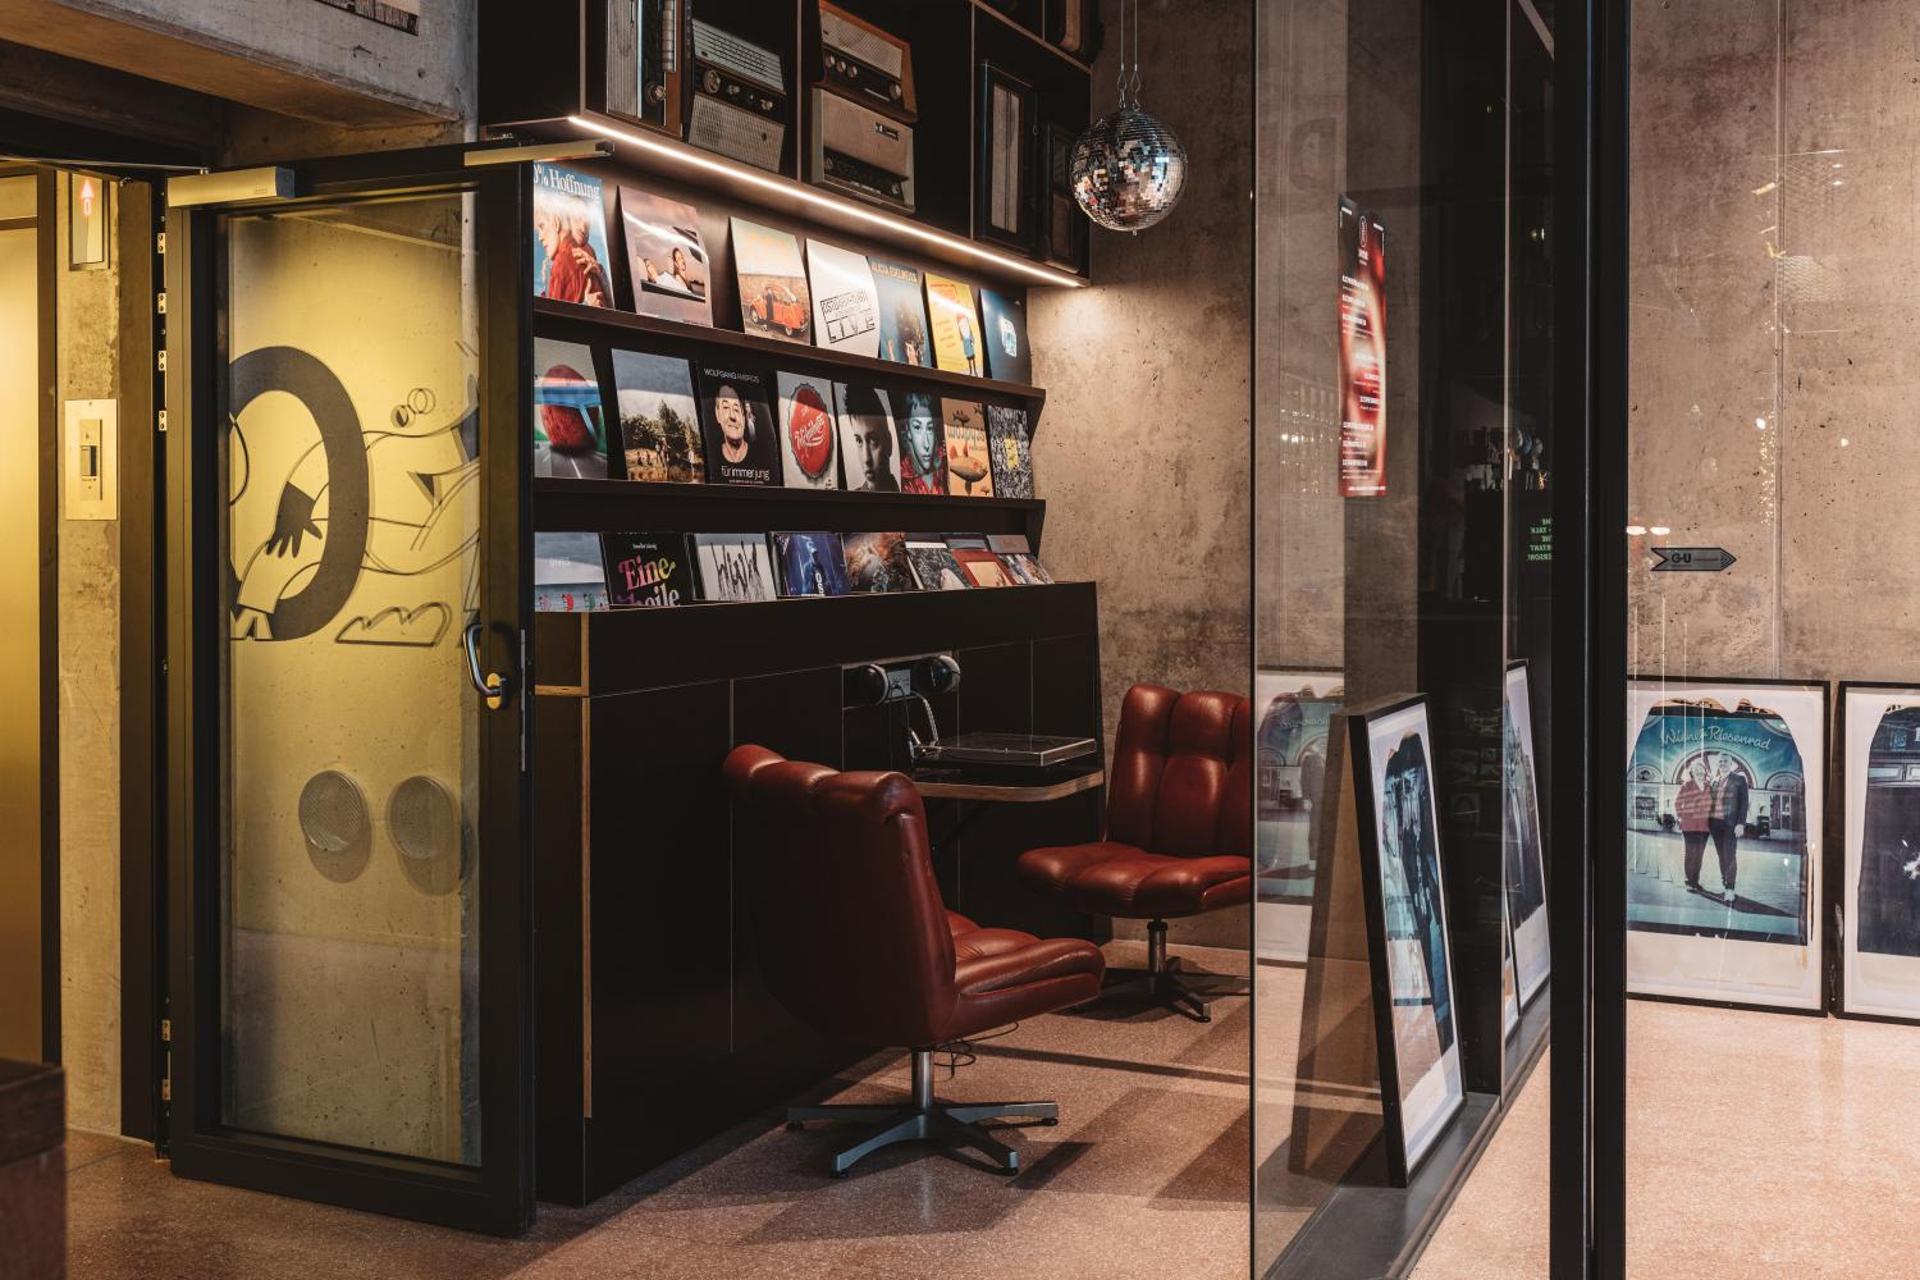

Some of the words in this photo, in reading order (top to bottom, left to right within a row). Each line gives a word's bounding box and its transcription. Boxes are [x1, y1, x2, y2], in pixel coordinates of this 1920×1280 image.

[549, 168, 600, 200] Hoffnung
[704, 368, 737, 380] WOLFGANG
[618, 555, 677, 591] Eine
[1708, 725, 1772, 749] Riesenrad
